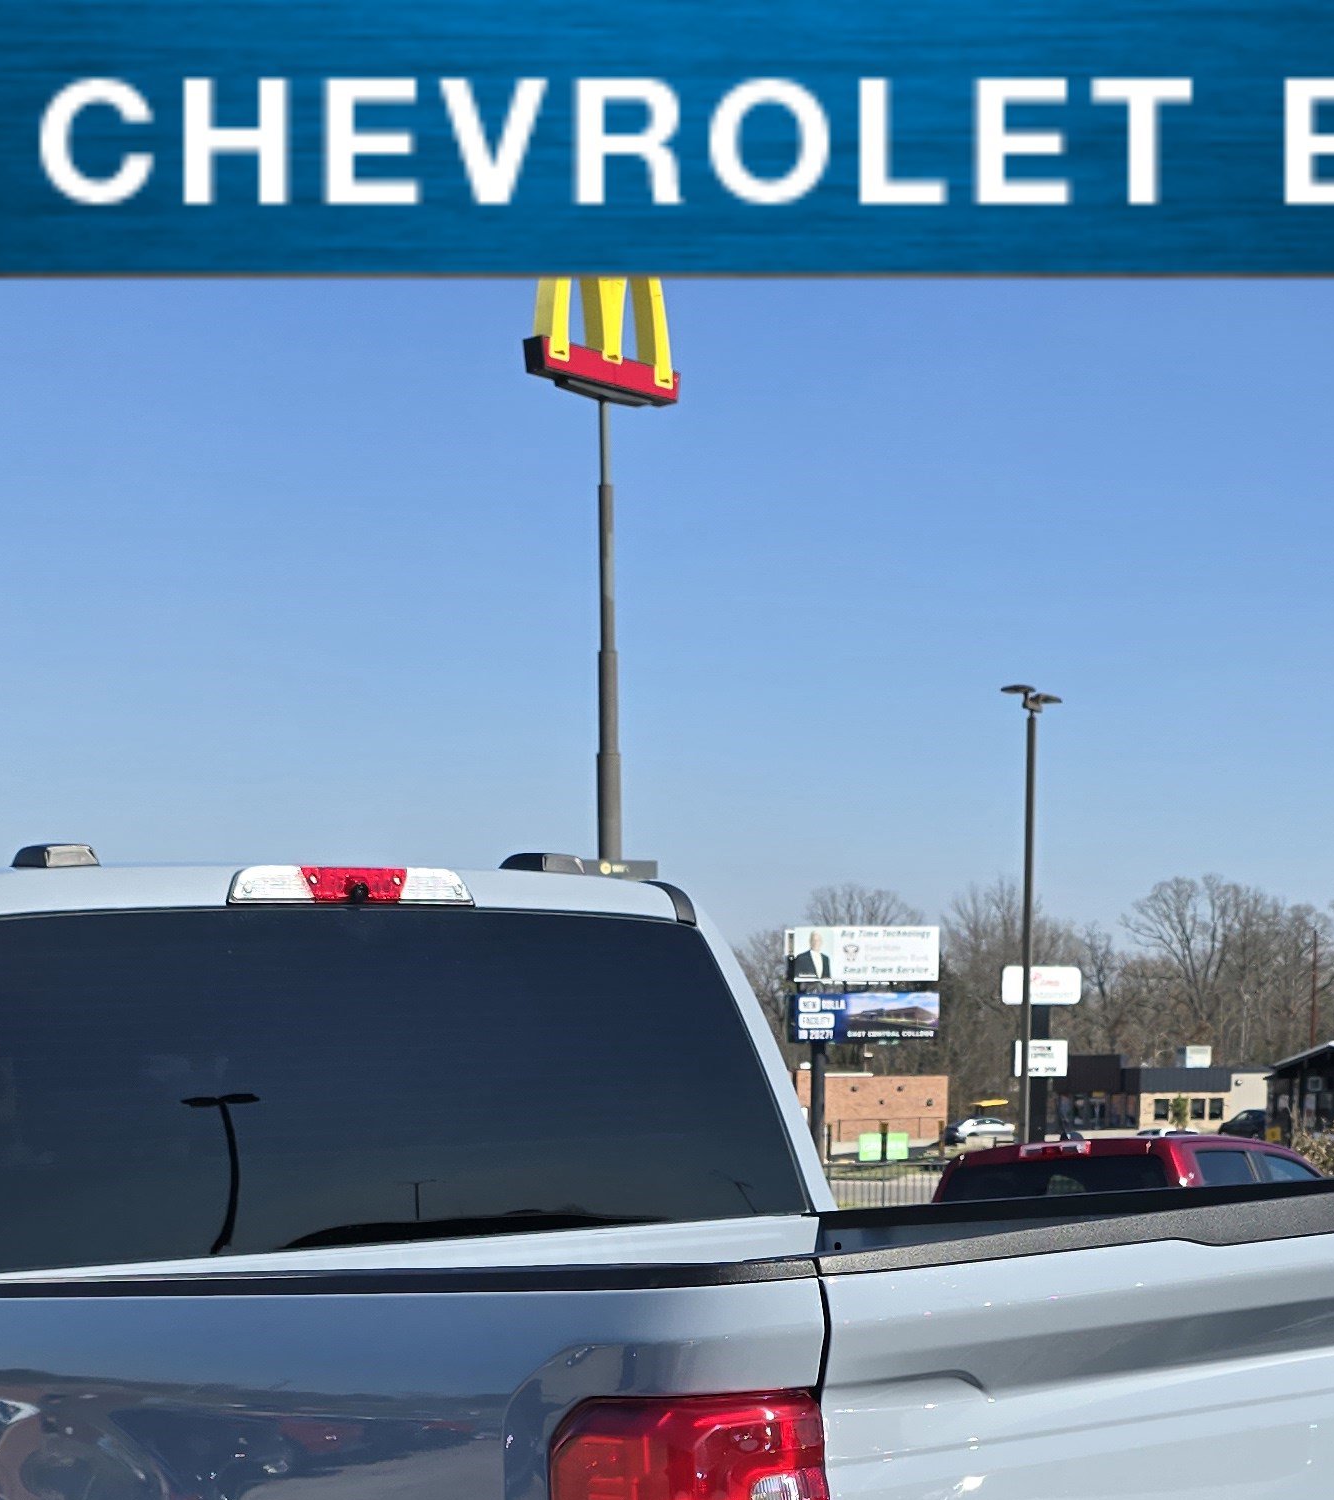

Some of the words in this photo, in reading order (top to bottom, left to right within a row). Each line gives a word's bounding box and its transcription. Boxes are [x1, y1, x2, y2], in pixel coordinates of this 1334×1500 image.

[858, 930, 879, 938] Time
[882, 930, 931, 941] Technology
[842, 966, 868, 975] Small
[871, 966, 894, 974] Town
[896, 966, 930, 974] Service
[802, 1000, 817, 1010] NEW
[802, 1016, 831, 1026] FACILITY
